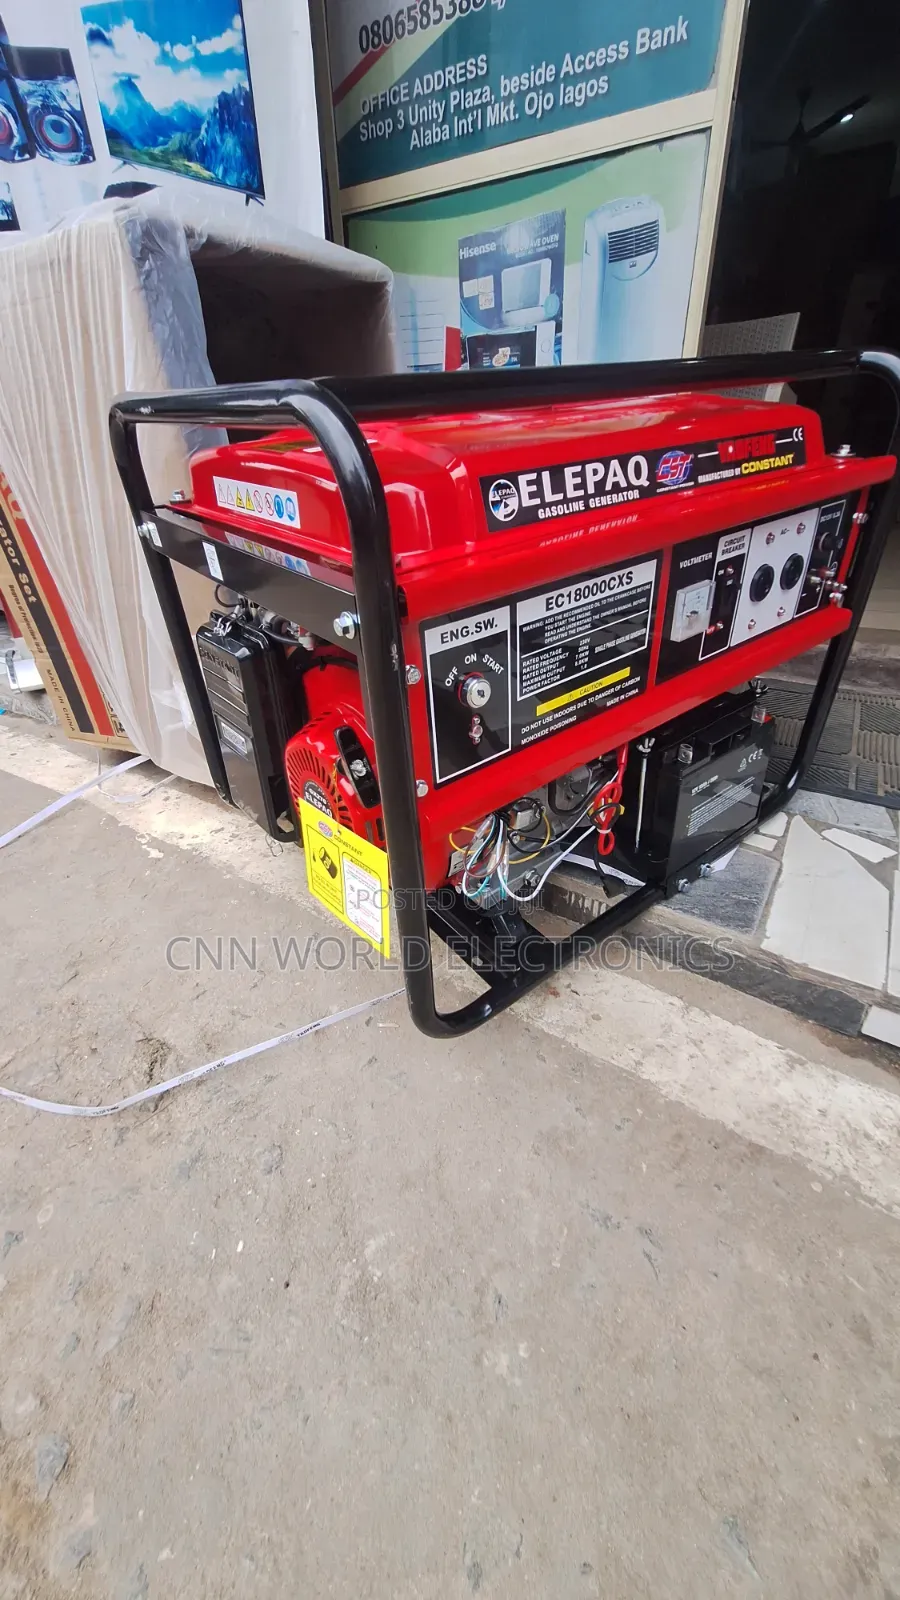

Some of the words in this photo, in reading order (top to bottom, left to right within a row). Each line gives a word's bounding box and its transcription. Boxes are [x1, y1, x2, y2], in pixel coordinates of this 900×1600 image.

[360, 119, 393, 142] Shop
[397, 110, 405, 130] 3
[409, 100, 446, 125] Unity
[451, 86, 494, 112] Plaza,
[500, 61, 556, 97] beside
[560, 40, 629, 78] Access
[636, 16, 689, 54] Bank
[361, 82, 409, 115] OFFICE
[413, 54, 488, 98] ADDRESS
[410, 122, 450, 150] Alaba
[487, 100, 519, 127] Mkt.
[524, 92, 554, 118] Ojo
[458, 240, 497, 260] Hisense
[542, 234, 559, 247] OVEN
[792, 427, 804, 442] CE
[698, 469, 734, 484] MANUFACTURED
[741, 454, 794, 474] CONSTANT
[518, 454, 650, 508] ELEPAQ
[538, 500, 585, 519] GASOLINE
[589, 489, 640, 508] GENERATOR
[722, 543, 745, 556] BREAKER
[724, 535, 746, 547] CIRCUIT
[680, 552, 712, 568] VOLTMETER
[19, 573, 37, 603] Set
[545, 571, 633, 612] EC18000CXS
[522, 621, 544, 632] WARNING:
[545, 616, 554, 624] ADD
[563, 604, 593, 618] RECOMMENDED
[554, 619, 568, 628] START
[568, 616, 576, 624] THE
[441, 617, 498, 644] ENG.SW.
[545, 630, 556, 638] READ
[545, 634, 568, 644] OPERATING
[465, 653, 477, 664] ON
[483, 654, 504, 675] START
[523, 656, 540, 667] RATED
[540, 648, 562, 660] VOLTAGE
[523, 663, 540, 674] RATED
[540, 652, 569, 666] FREQUENCY
[445, 666, 458, 687] OFF
[523, 670, 540, 680] RATED
[540, 662, 559, 673] OUTPUT
[523, 675, 546, 687] MAXIMUM
[546, 666, 566, 678] OUTPUT
[523, 683, 540, 694] POWER
[541, 674, 560, 686] FACTOR
[580, 682, 602, 694] CAUTION
[47, 669, 60, 692] MADE
[58, 696, 64, 704] IN
[62, 707, 76, 732] CHINA
[522, 726, 530, 734] DO
[530, 721, 541, 730] NOT
[543, 716, 553, 724] USE
[554, 706, 576, 719] INDOORS
[577, 700, 587, 708] DUE
[595, 688, 614, 700] DANGER
[622, 676, 640, 688] CARBON
[606, 698, 619, 706] MADE
[620, 694, 625, 702] IN
[626, 688, 638, 698] CHINA
[521, 728, 548, 745] MONOXIDE
[550, 716, 576, 732] POISONING
